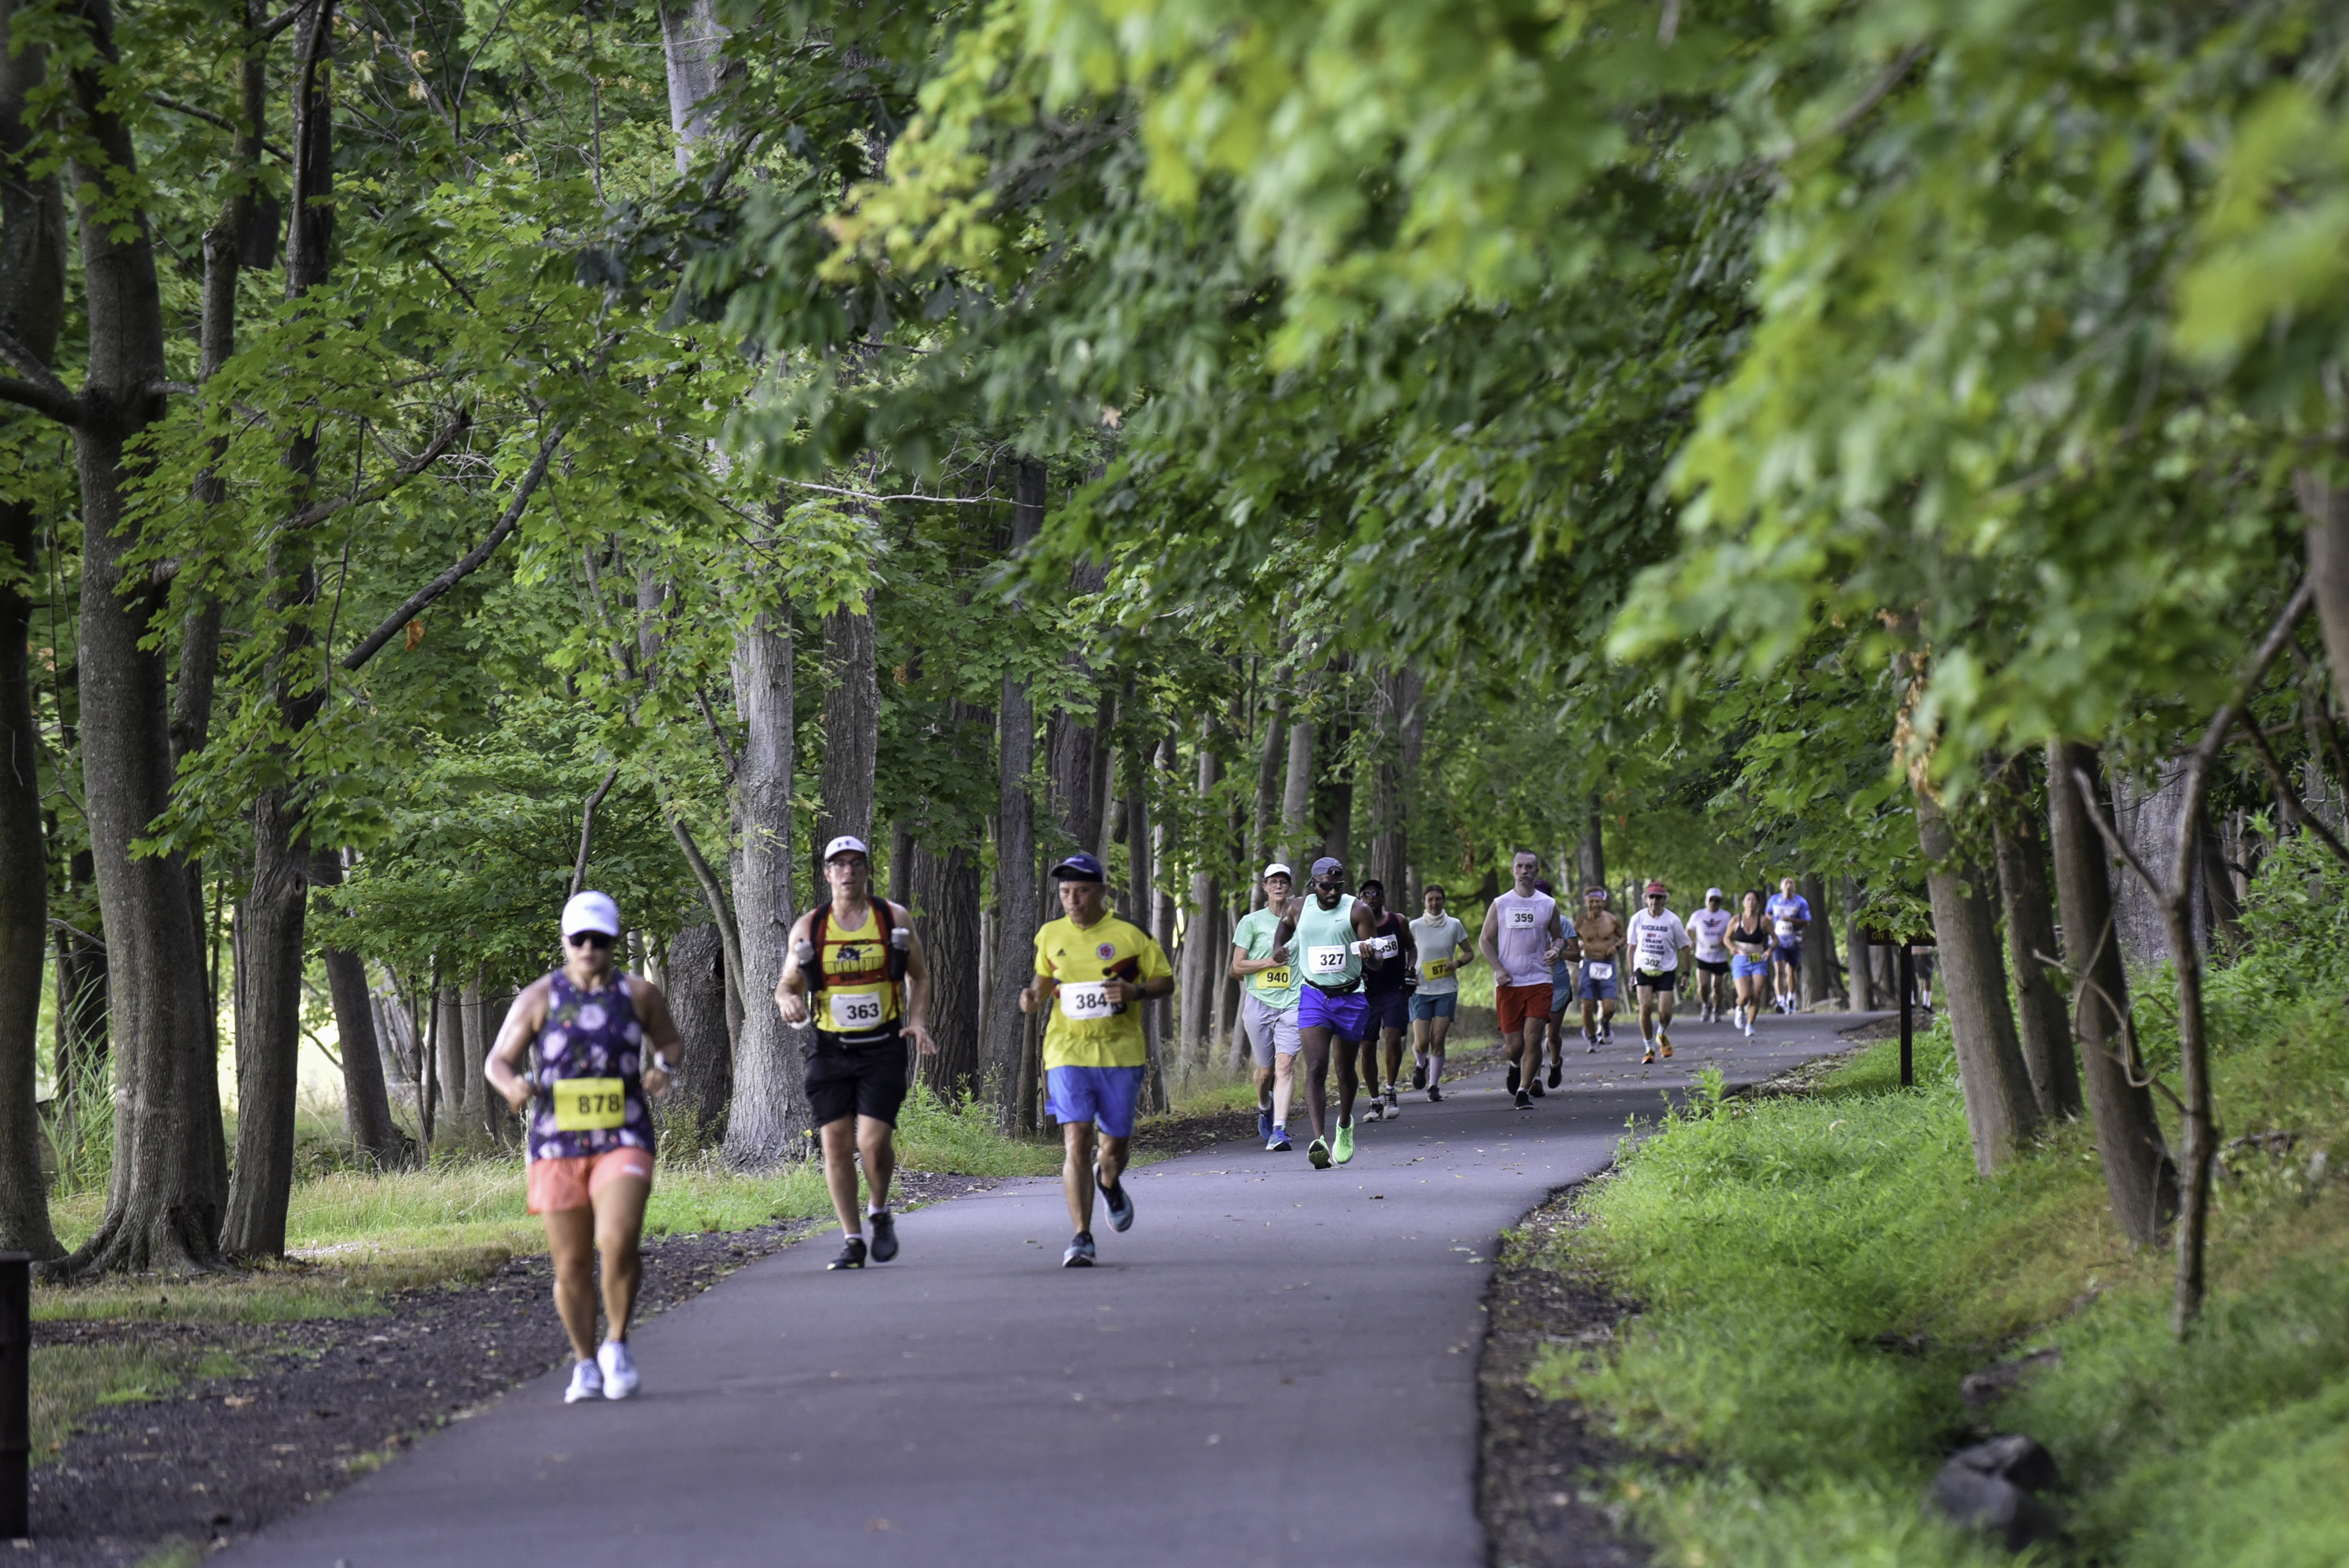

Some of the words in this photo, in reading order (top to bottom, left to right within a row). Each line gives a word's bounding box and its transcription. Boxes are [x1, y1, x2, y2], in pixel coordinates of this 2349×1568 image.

[1515, 913, 1534, 923] 359
[1641, 924, 1669, 933] RICHARD
[1872, 931, 1884, 940] ON
[1320, 953, 1344, 966] 327
[1645, 957, 1660, 967] 302
[1267, 972, 1289, 984] 940
[1076, 993, 1108, 1009] 384
[846, 1003, 879, 1020] 363
[579, 1093, 620, 1114] 878
